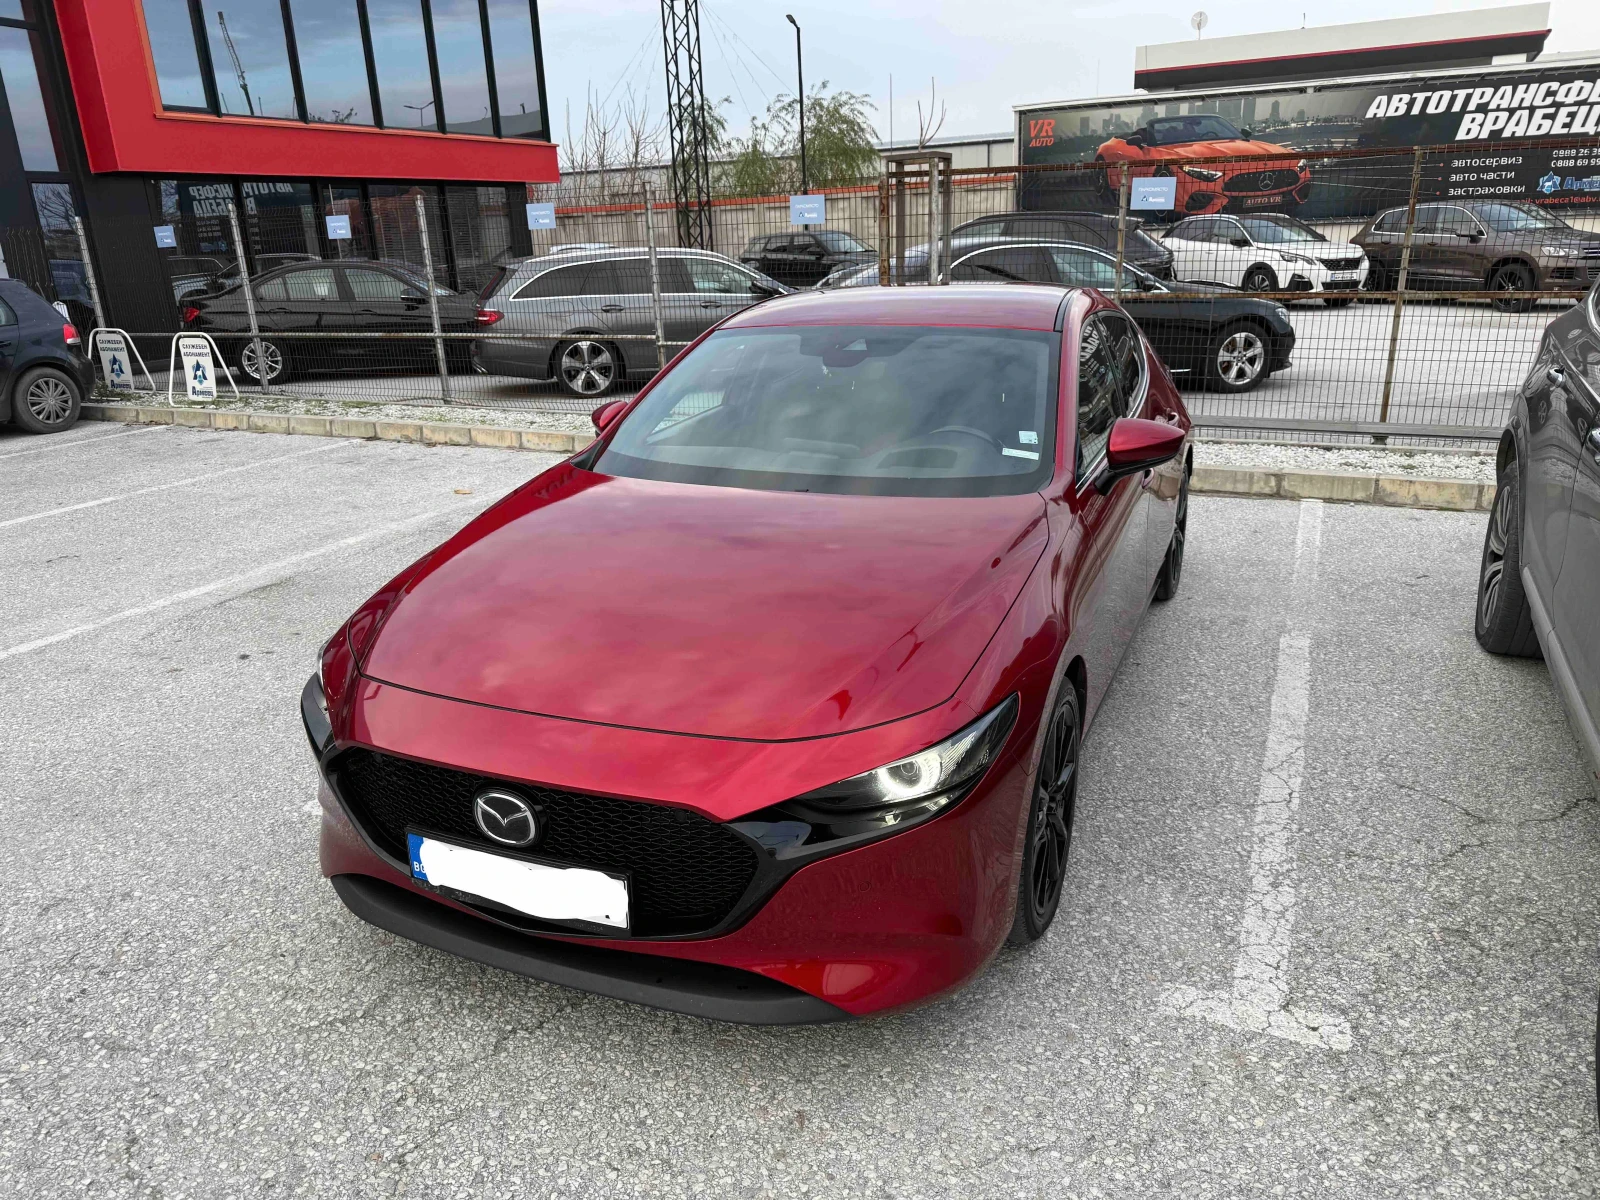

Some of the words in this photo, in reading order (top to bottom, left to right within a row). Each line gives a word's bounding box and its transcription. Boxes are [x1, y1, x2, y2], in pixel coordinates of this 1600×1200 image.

[1455, 105, 1600, 140] ВРАБЕЦ
[1029, 119, 1055, 138] VR
[1029, 138, 1055, 147] AUTO
[1451, 156, 1523, 168] автосервиз
[1449, 173, 1477, 182] авто
[1480, 171, 1515, 181] части
[1448, 185, 1525, 196] застраховки
[1246, 197, 1269, 206] AUTO
